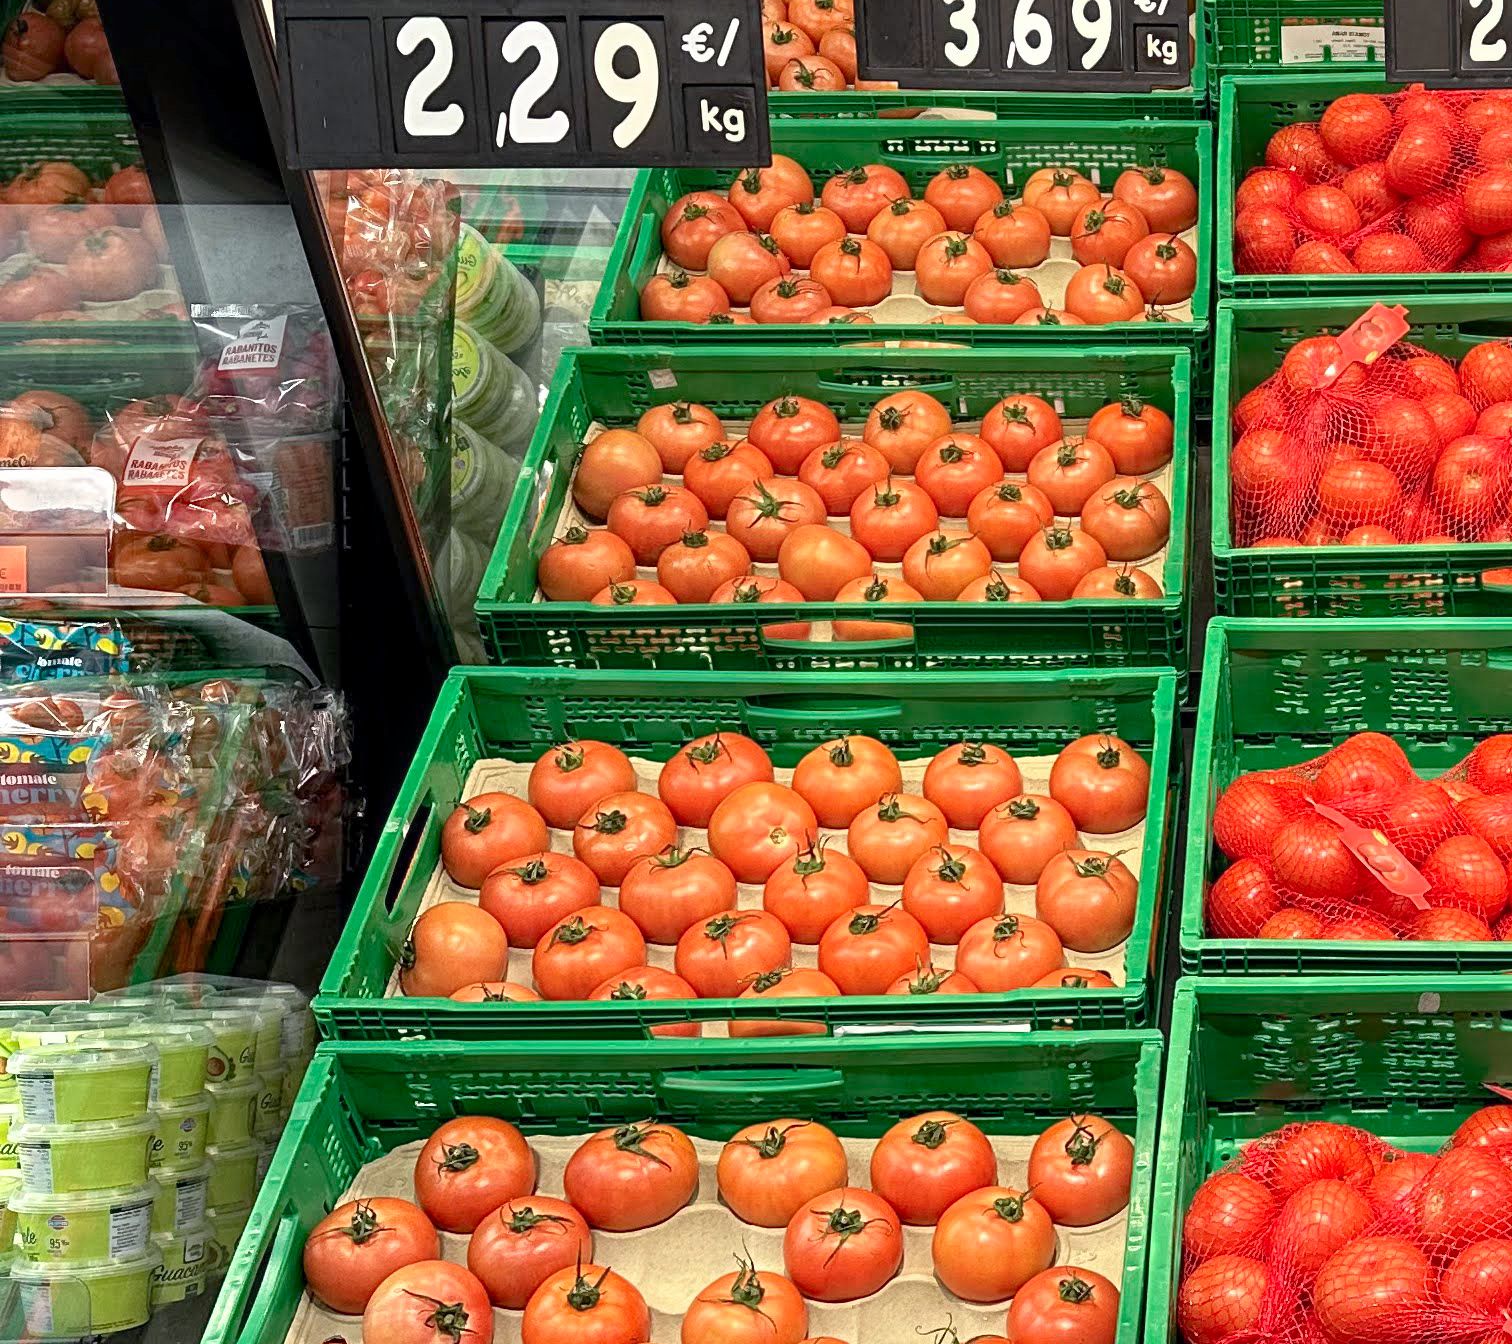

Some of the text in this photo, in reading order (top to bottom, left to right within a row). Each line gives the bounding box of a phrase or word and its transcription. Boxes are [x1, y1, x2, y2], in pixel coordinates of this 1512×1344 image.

[1146, 33, 1178, 65] kg
[396, 16, 660, 149] 2,29
[700, 99, 746, 143] kg
[0, 773, 57, 785] tomate
